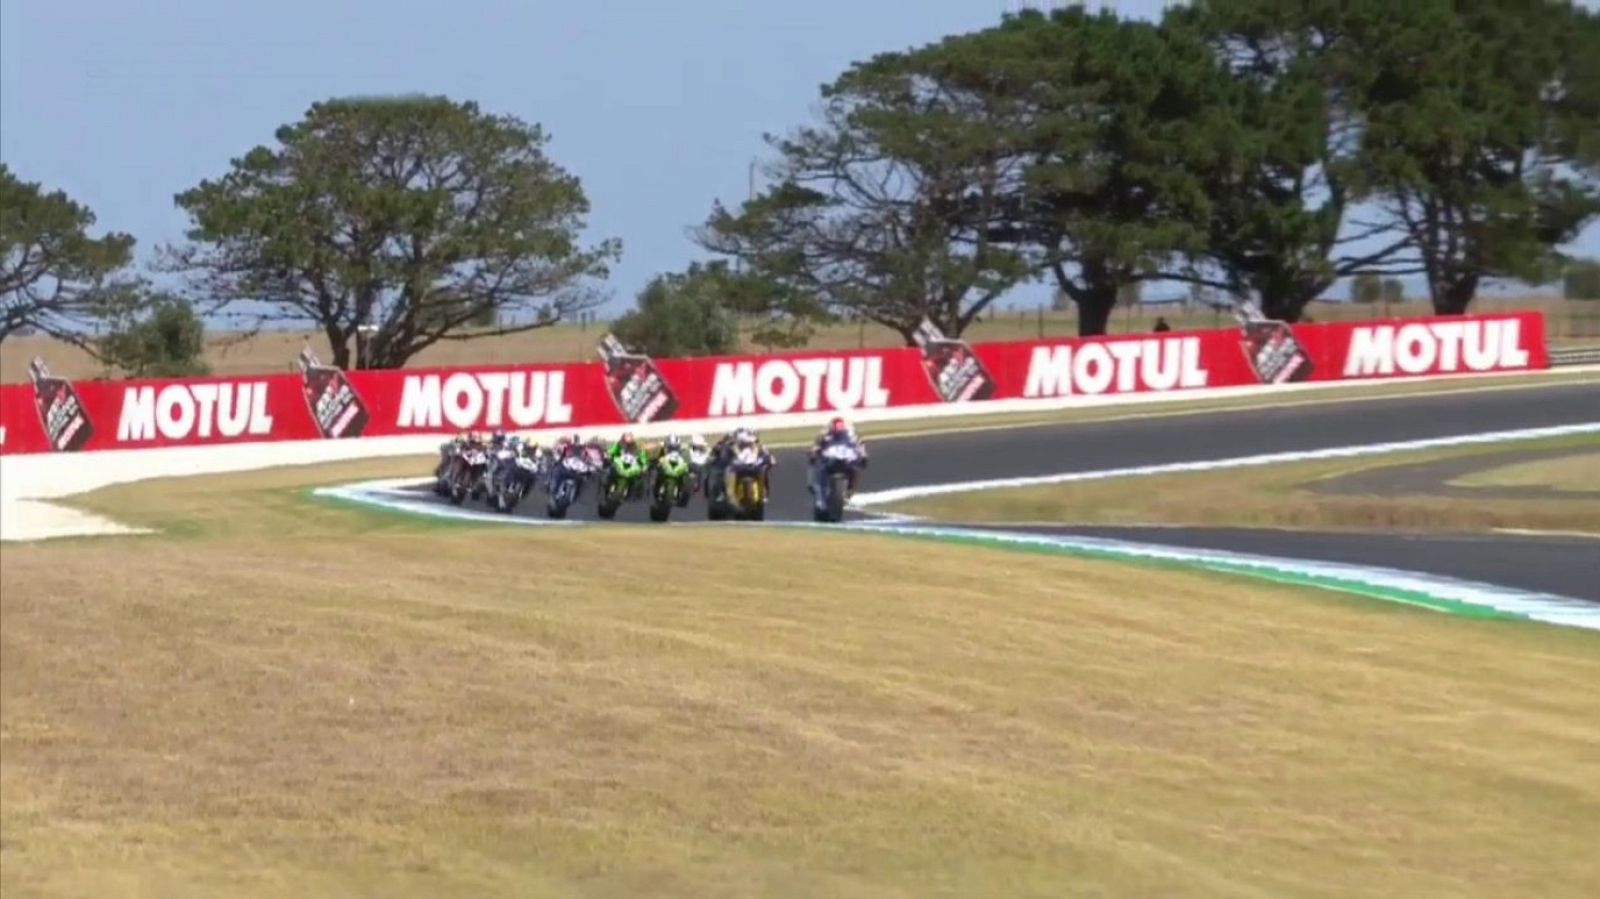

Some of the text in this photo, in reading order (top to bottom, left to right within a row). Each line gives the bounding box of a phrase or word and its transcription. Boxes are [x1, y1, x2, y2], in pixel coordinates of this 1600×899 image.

[1022, 336, 1209, 397] MOTUL
[1343, 318, 1529, 375] MOTUL
[117, 382, 273, 441] MOTUL
[396, 370, 573, 428] MOTUL
[708, 356, 889, 415] MOTUL
